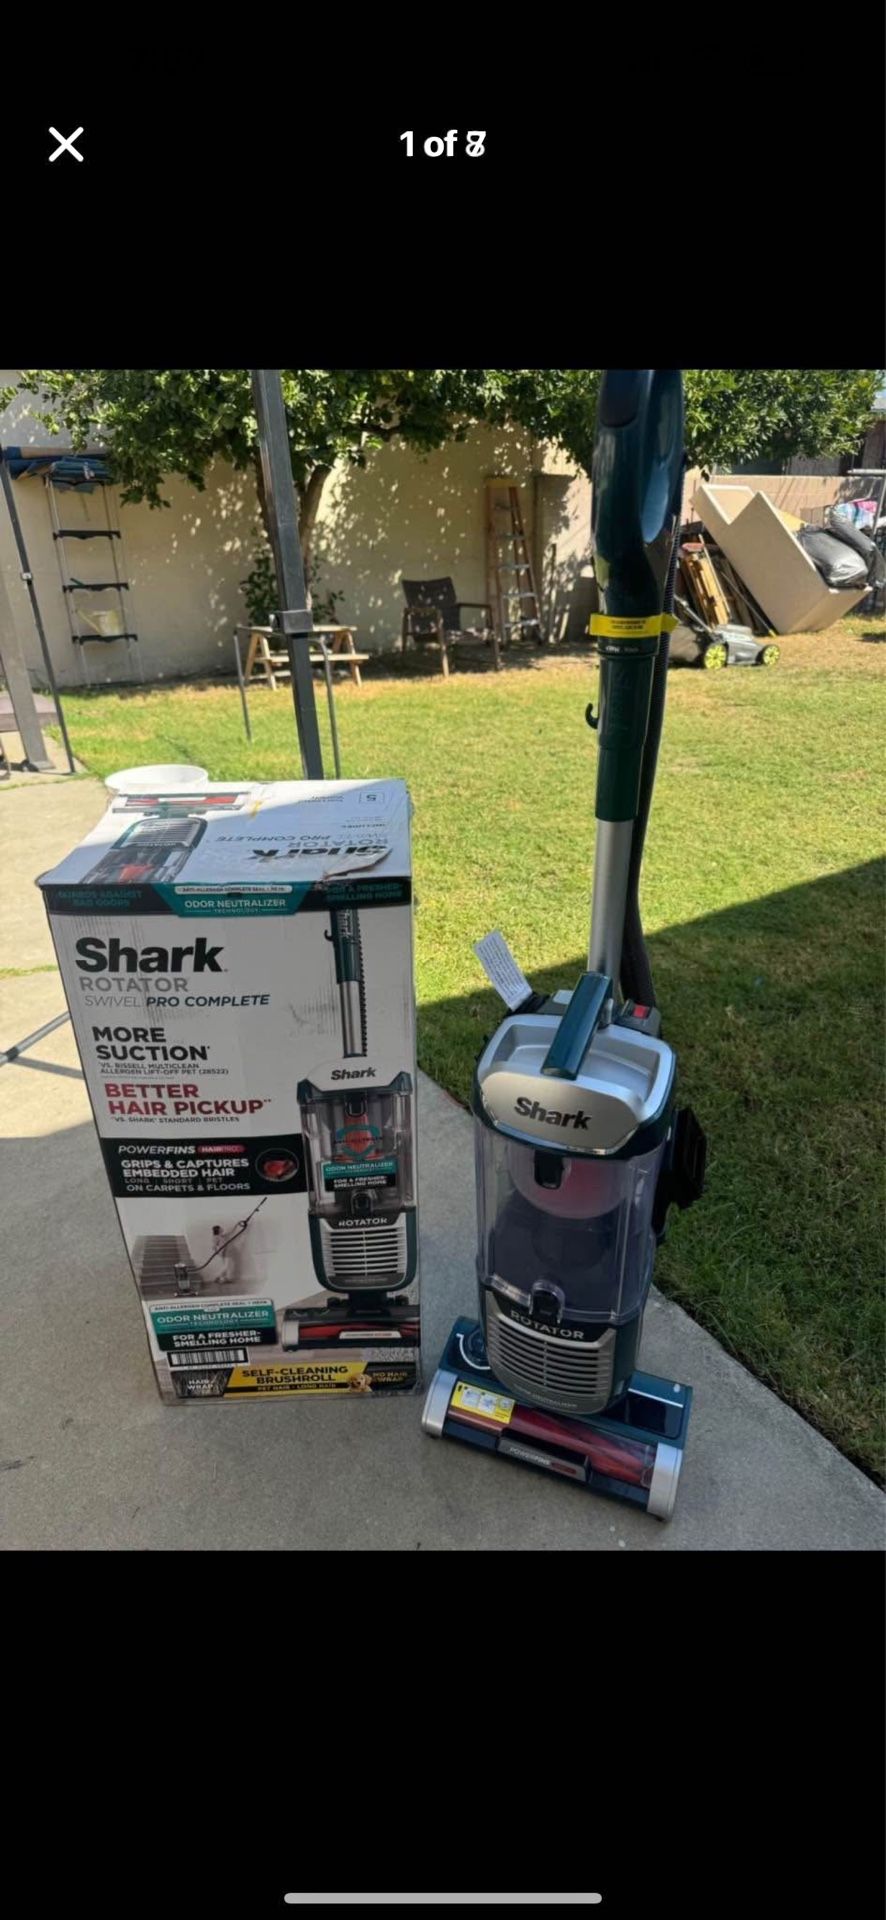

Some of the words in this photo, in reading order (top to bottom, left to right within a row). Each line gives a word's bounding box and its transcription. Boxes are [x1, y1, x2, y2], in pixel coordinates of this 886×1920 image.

[215, 835, 295, 843] COMPLETE
[288, 839, 388, 848] ROTATOR
[184, 900, 215, 908] ODOR
[217, 899, 286, 909] NEUTRALIZER
[75, 937, 226, 972] Shark
[79, 977, 189, 992] ROTATOR
[84, 995, 140, 1007] SWIVEL
[146, 996, 180, 1008] PRO
[184, 994, 270, 1007] COMPLETE
[92, 1026, 167, 1043] MORE
[331, 1067, 377, 1080] Shark
[104, 1083, 200, 1098] BETTER
[108, 1101, 168, 1116] HAIR
[514, 1096, 593, 1131] Shark
[118, 1145, 196, 1154] POWERFINS
[121, 1160, 161, 1169] GRIPS
[164, 1160, 174, 1168] &
[176, 1158, 250, 1168] CAPTURES
[123, 1169, 198, 1178] EMBEDDED
[201, 1168, 235, 1177] HAIR
[126, 1184, 144, 1192] ON
[146, 1184, 194, 1192] CARPETS
[197, 1184, 204, 1192] &
[207, 1183, 250, 1191] FLOORS
[338, 1218, 388, 1226] ROTATOR
[157, 1315, 190, 1324] ODOR
[193, 1310, 269, 1321] NEUTRALIZER
[510, 1310, 585, 1339] ROTATOR
[208, 1330, 261, 1338] FRESHER-
[174, 1338, 227, 1347] SMELLING
[229, 1336, 261, 1344] HOME
[242, 1366, 348, 1377] SELF-CLEANING
[256, 1374, 337, 1384] BRUSHROLL
